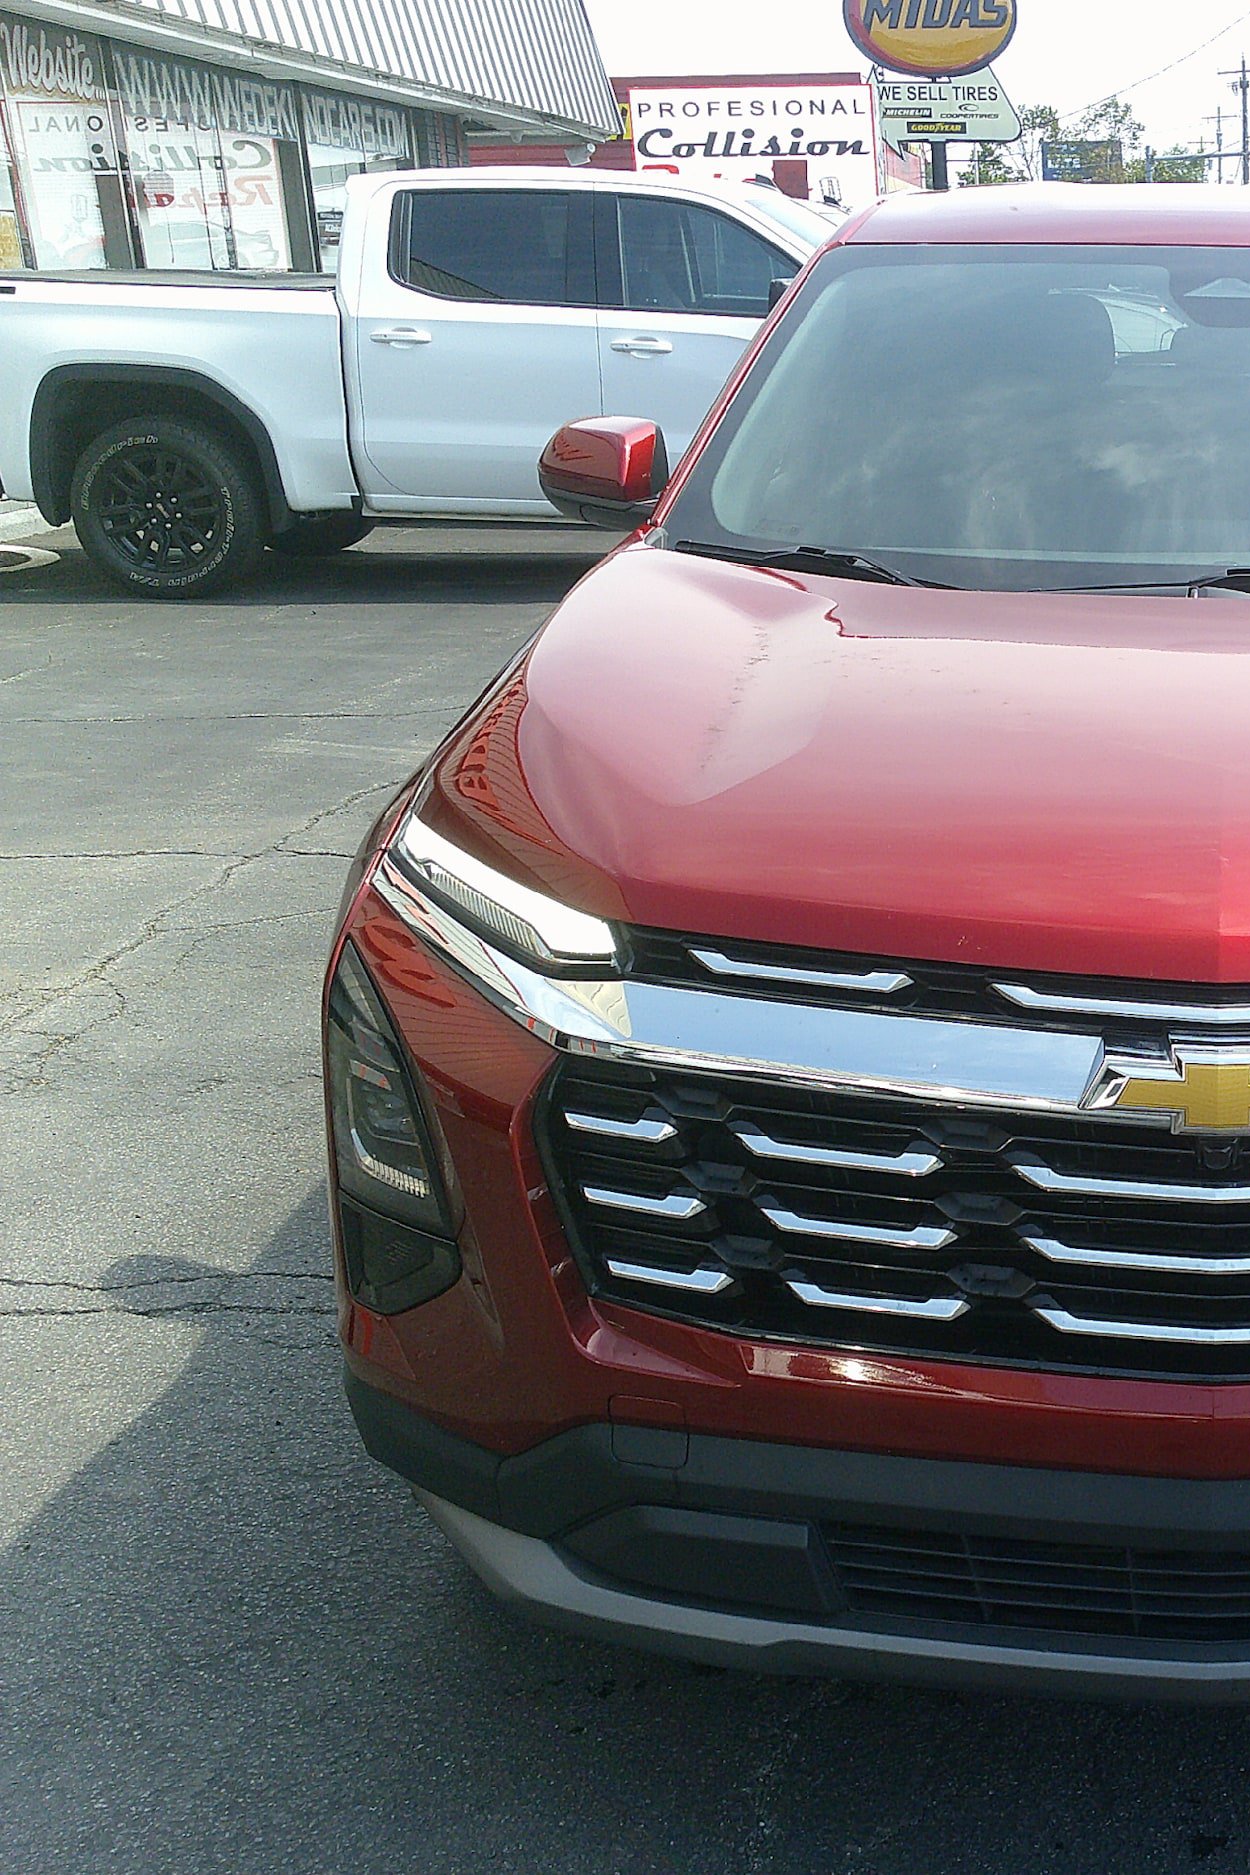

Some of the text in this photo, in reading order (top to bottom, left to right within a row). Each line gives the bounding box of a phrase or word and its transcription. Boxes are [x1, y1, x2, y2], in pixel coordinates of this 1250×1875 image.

[864, 0, 1008, 29] MIDAS
[880, 86, 998, 101] WE SELL TIRES
[637, 99, 866, 118] PROFESIONAL
[885, 108, 931, 117] MICHELIN
[637, 128, 871, 158] Collision
